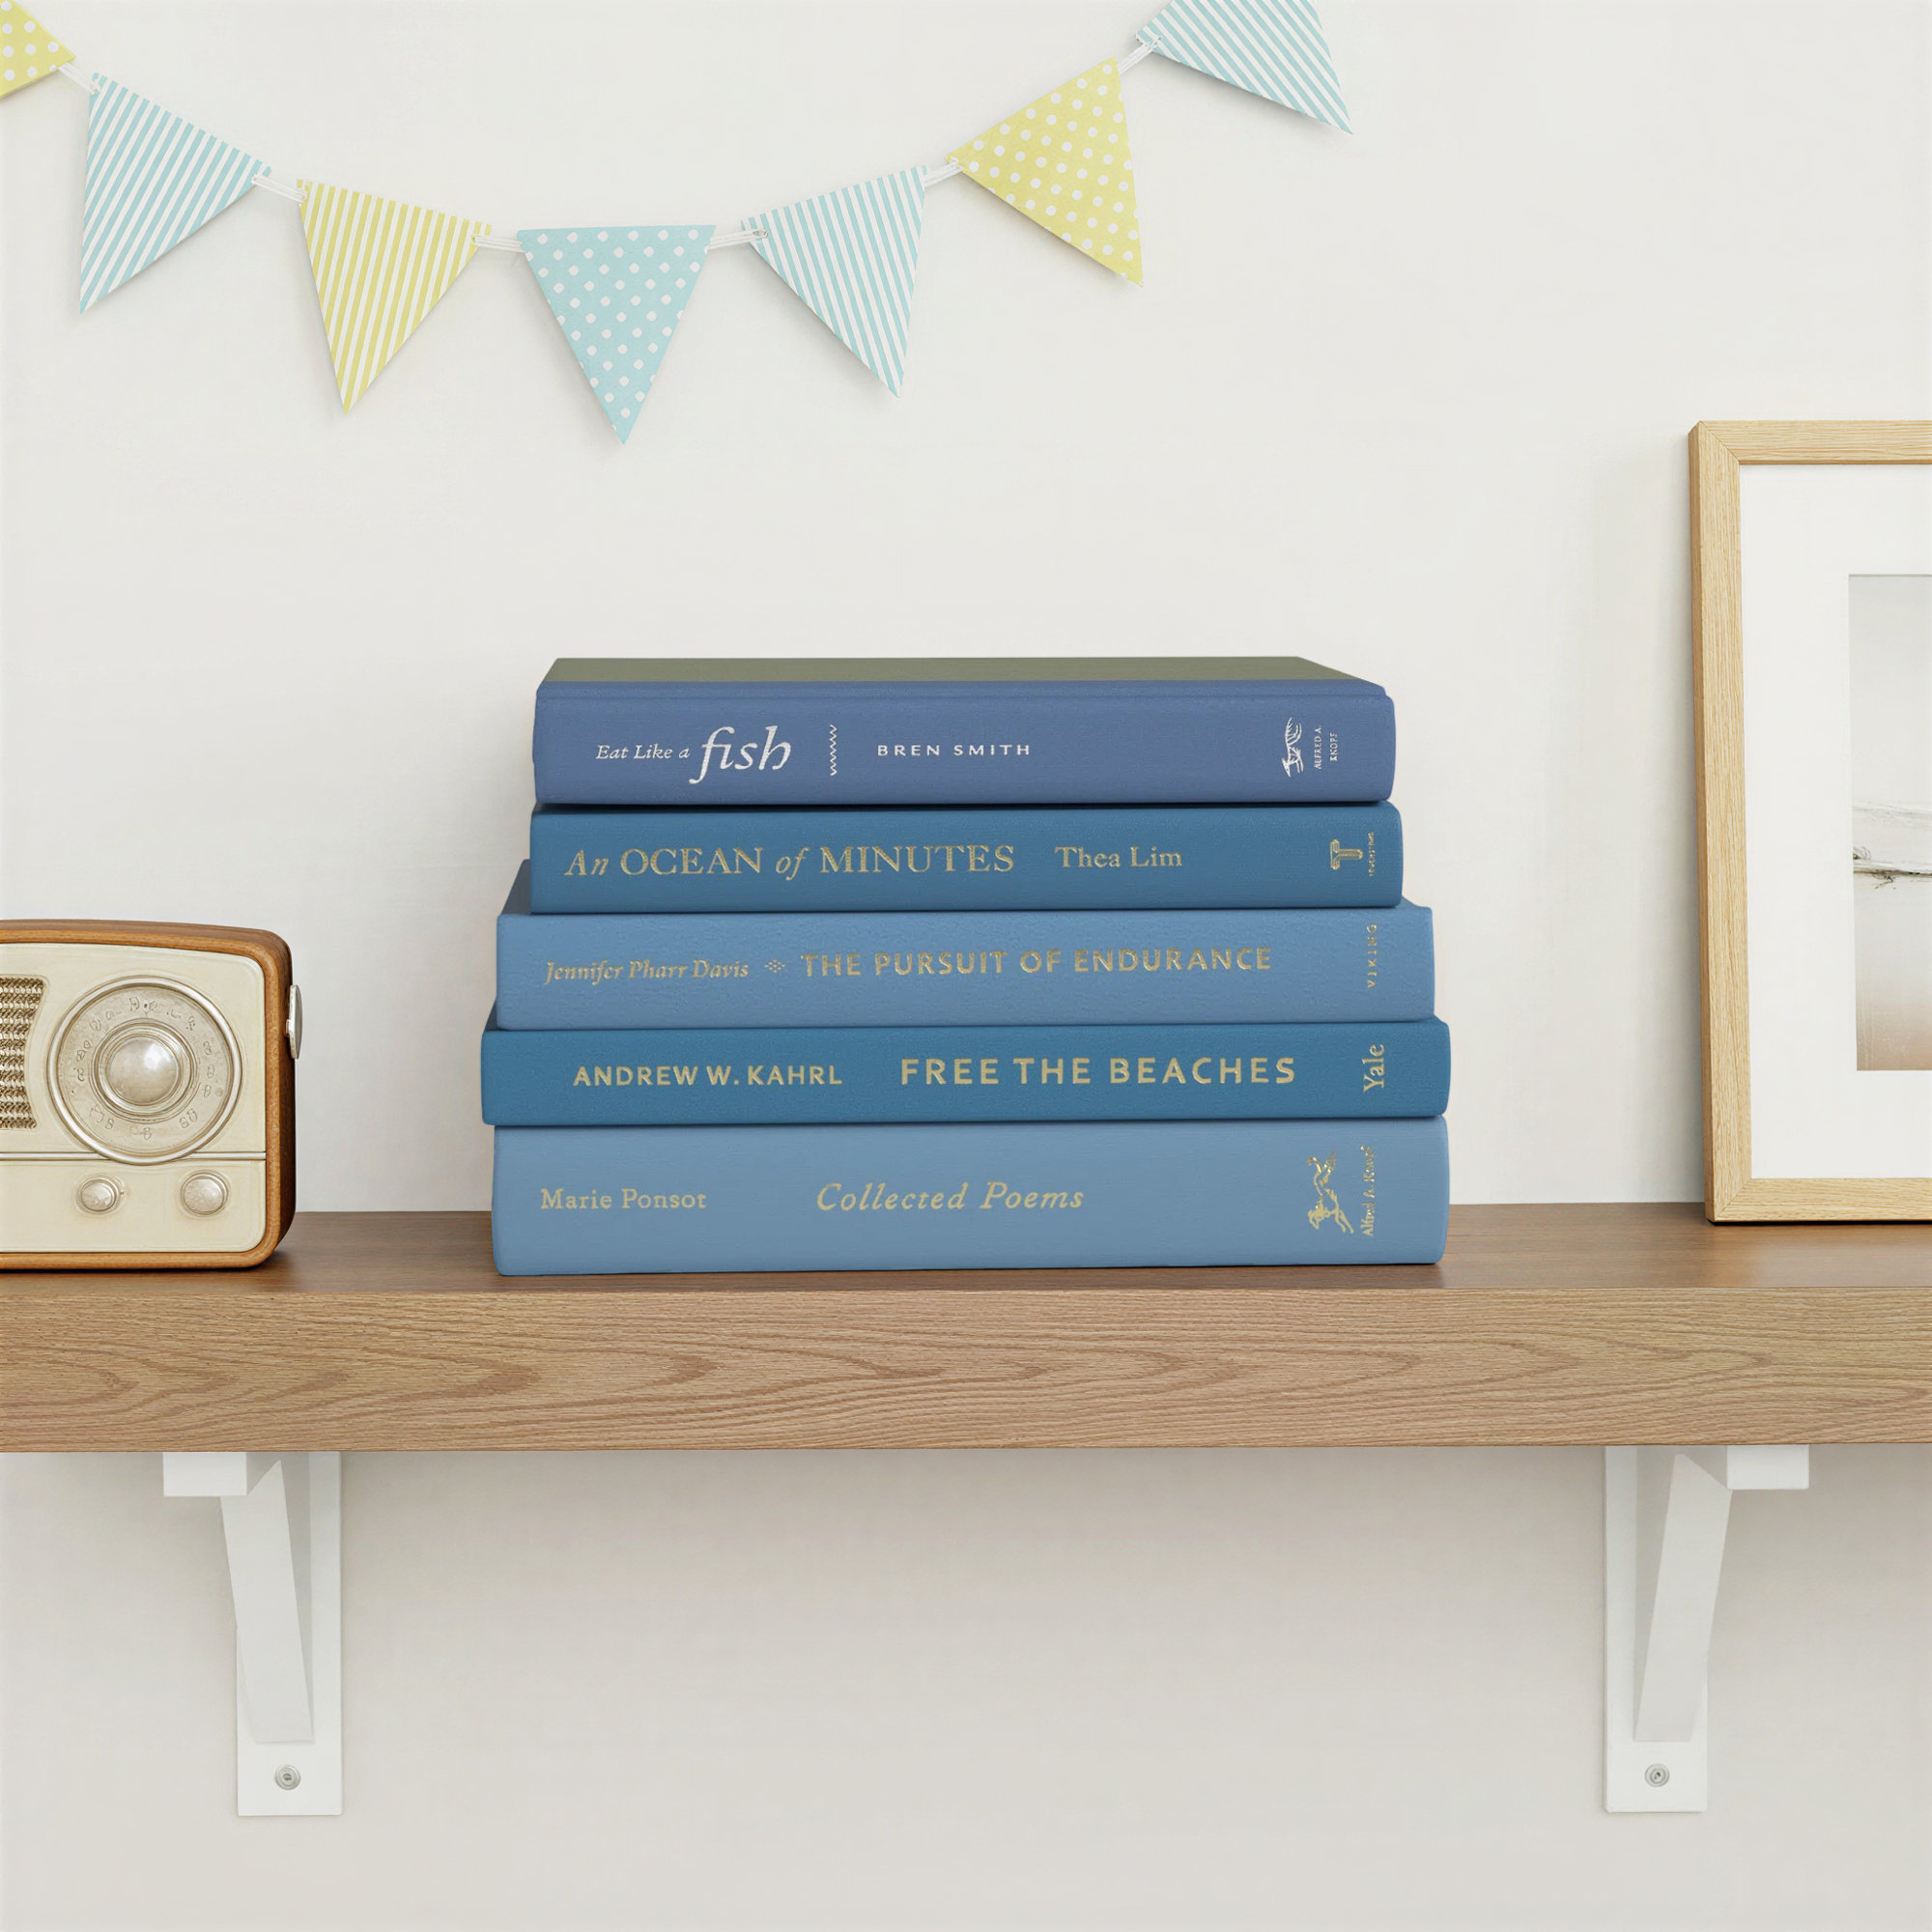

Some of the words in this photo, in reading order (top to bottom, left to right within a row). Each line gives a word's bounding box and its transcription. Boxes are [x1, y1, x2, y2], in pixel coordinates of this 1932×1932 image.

[595, 745, 629, 759] Eat
[633, 743, 673, 759] Like
[678, 748, 691, 759] a
[688, 725, 792, 784] fish
[876, 744, 941, 757] BREN
[952, 744, 1031, 756] SMITH
[563, 848, 610, 877] An
[619, 847, 764, 877] OCEAN
[775, 844, 810, 881] of
[819, 843, 1015, 874] MINUTES
[1054, 845, 1122, 868] Thea
[1129, 845, 1182, 867] Lim
[543, 958, 625, 986] Jennifer
[628, 958, 689, 980] Pharr
[691, 957, 751, 980] Davis
[800, 952, 863, 978] THE
[874, 950, 1009, 977] PURSUIT
[1019, 949, 1063, 975] OF
[1073, 946, 1273, 974] ENDURANCE
[1367, 923, 1378, 989] VIKING
[573, 1064, 699, 1088] ANDREW
[705, 1064, 741, 1087] W.
[747, 1064, 844, 1087] KAHRL
[900, 1057, 1001, 1086] FREE
[1012, 1056, 1093, 1086] THE
[1109, 1056, 1297, 1085] BEACHES
[1361, 1043, 1386, 1093] Yale
[540, 1187, 613, 1210] Marie
[621, 1186, 707, 1210] Ponsot
[816, 1181, 970, 1212] Collected
[979, 1180, 1086, 1211] Poems
